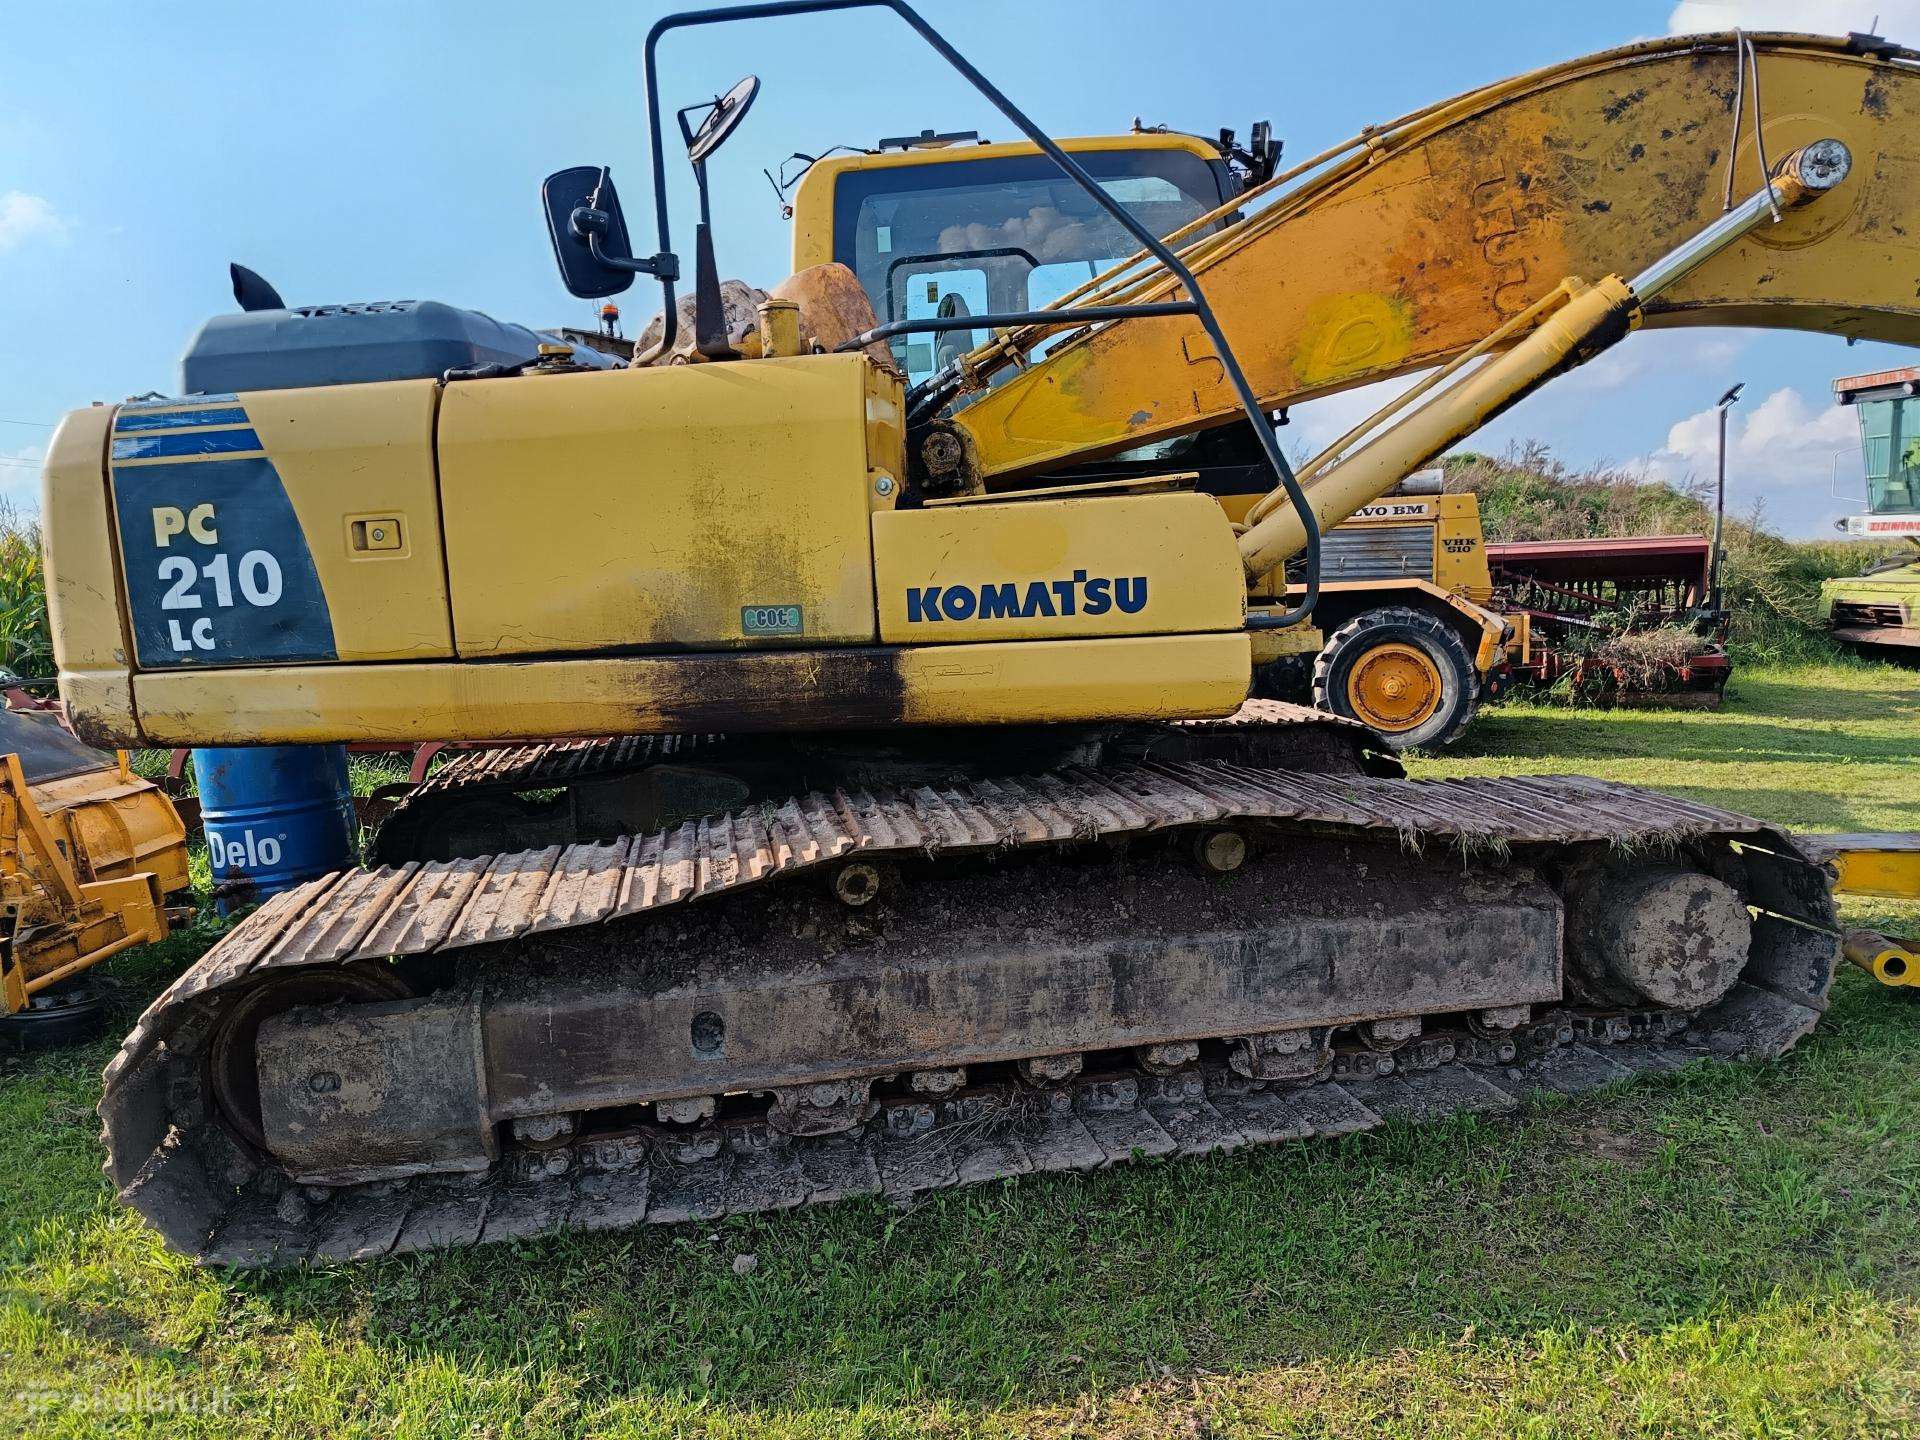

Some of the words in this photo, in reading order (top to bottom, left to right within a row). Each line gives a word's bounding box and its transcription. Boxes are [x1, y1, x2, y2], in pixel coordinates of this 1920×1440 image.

[152, 503, 218, 547] PC
[1392, 505, 1424, 515] BM
[1441, 538, 1477, 546] VHK
[158, 550, 283, 610] 210
[906, 569, 1148, 623] KOMATSU
[168, 617, 216, 652] LC
